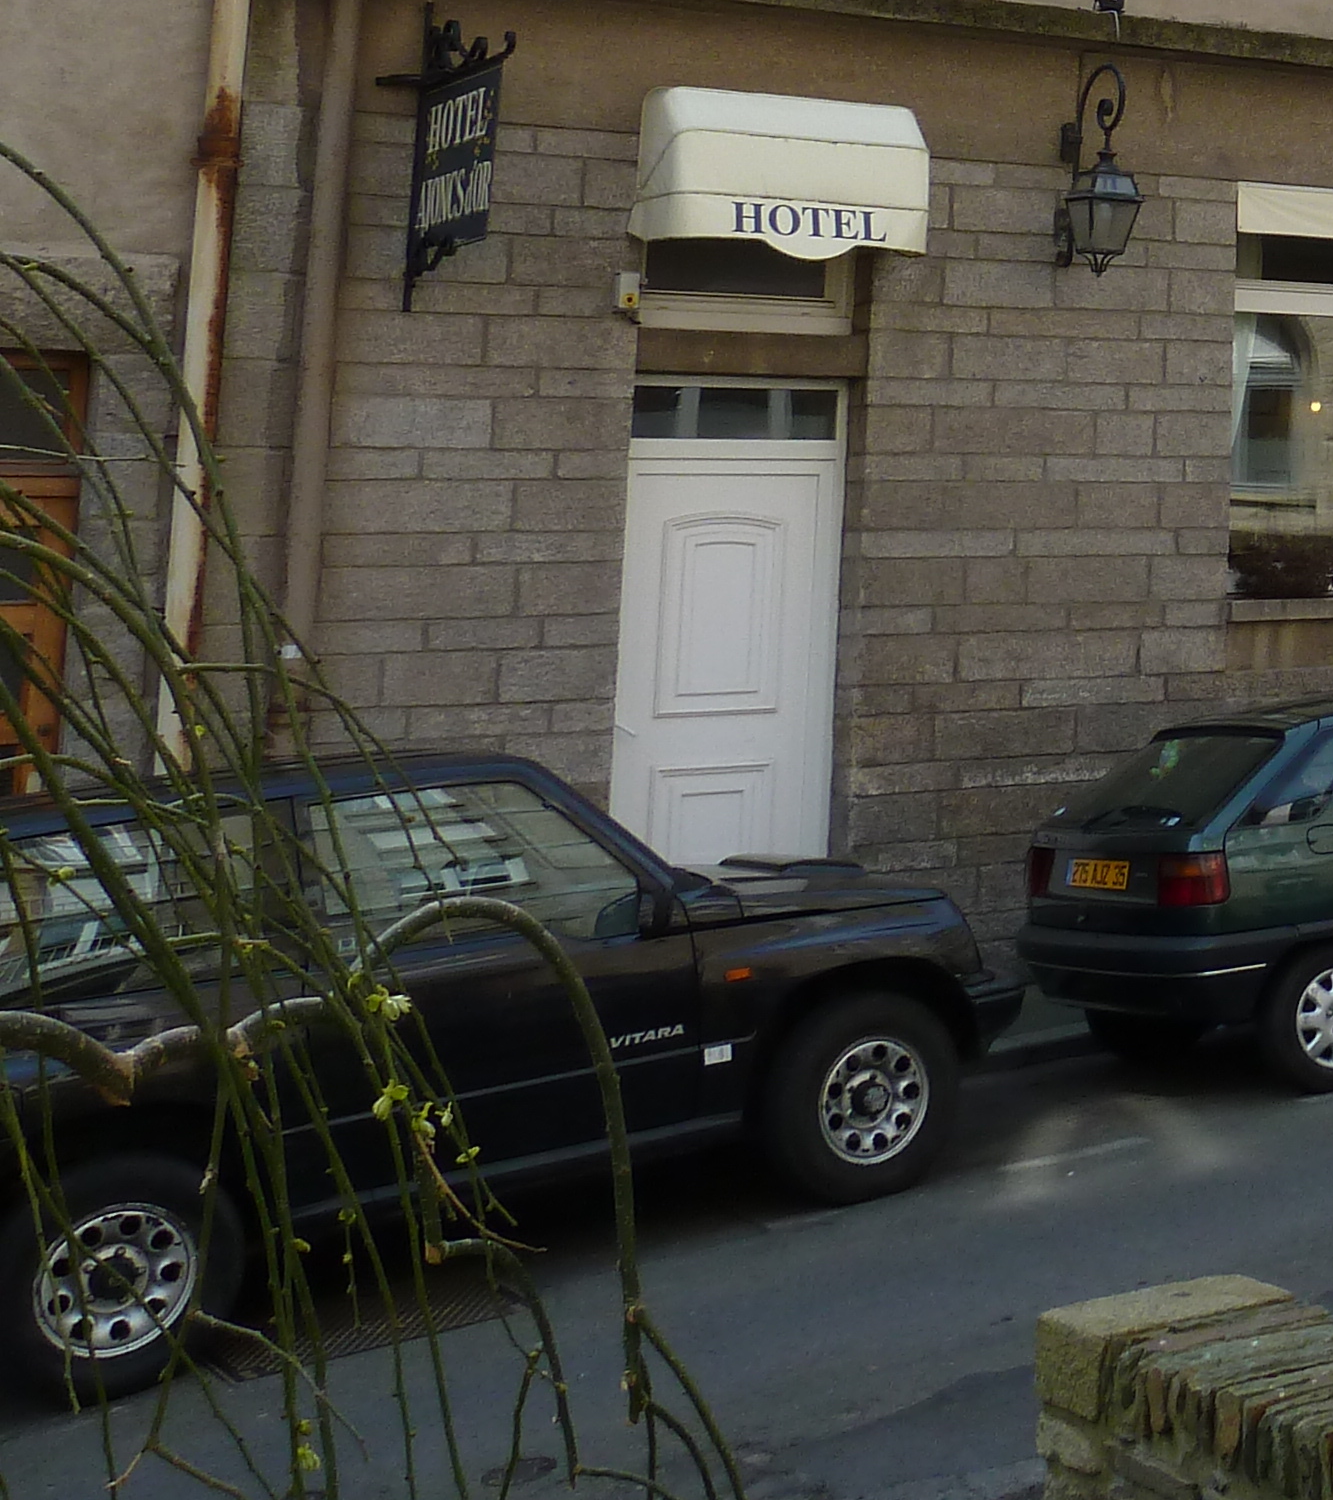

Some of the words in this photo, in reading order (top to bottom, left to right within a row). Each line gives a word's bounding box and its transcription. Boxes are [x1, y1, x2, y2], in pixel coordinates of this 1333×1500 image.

[427, 87, 488, 153] HOTEL
[414, 167, 466, 238] AJONCS
[731, 201, 887, 242] HOTEL
[1113, 864, 1127, 887] 35
[610, 1023, 685, 1049] VITARA
